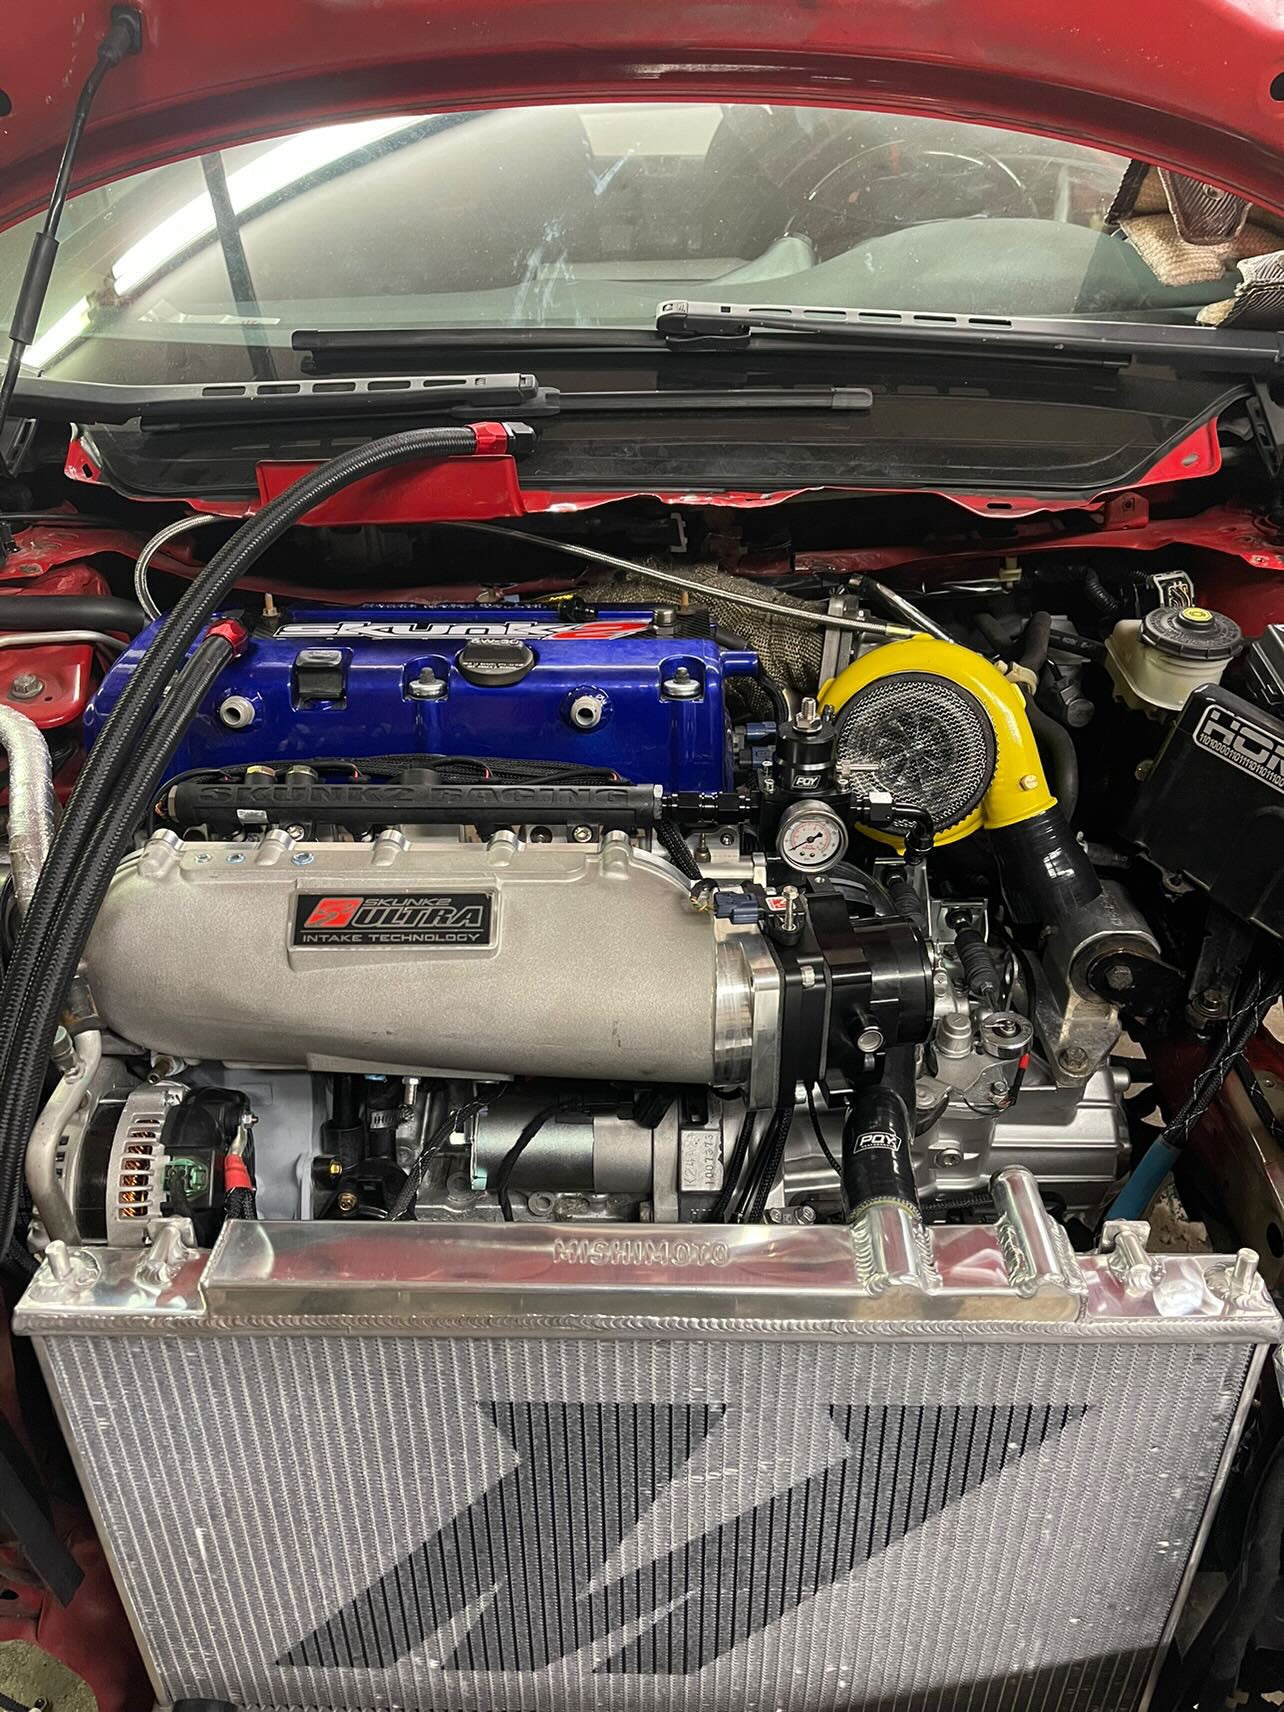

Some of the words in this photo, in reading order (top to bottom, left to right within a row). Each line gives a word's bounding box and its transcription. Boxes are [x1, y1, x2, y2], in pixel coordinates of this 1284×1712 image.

[201, 786, 415, 802] SKUNK2
[431, 786, 629, 803] RACING
[363, 898, 452, 907] SKUNK2
[352, 906, 485, 928] ULTRA
[303, 934, 362, 943] INTAKE
[368, 934, 480, 943] TECHNOLOGY
[552, 1237, 731, 1268] MISHIMOTO
